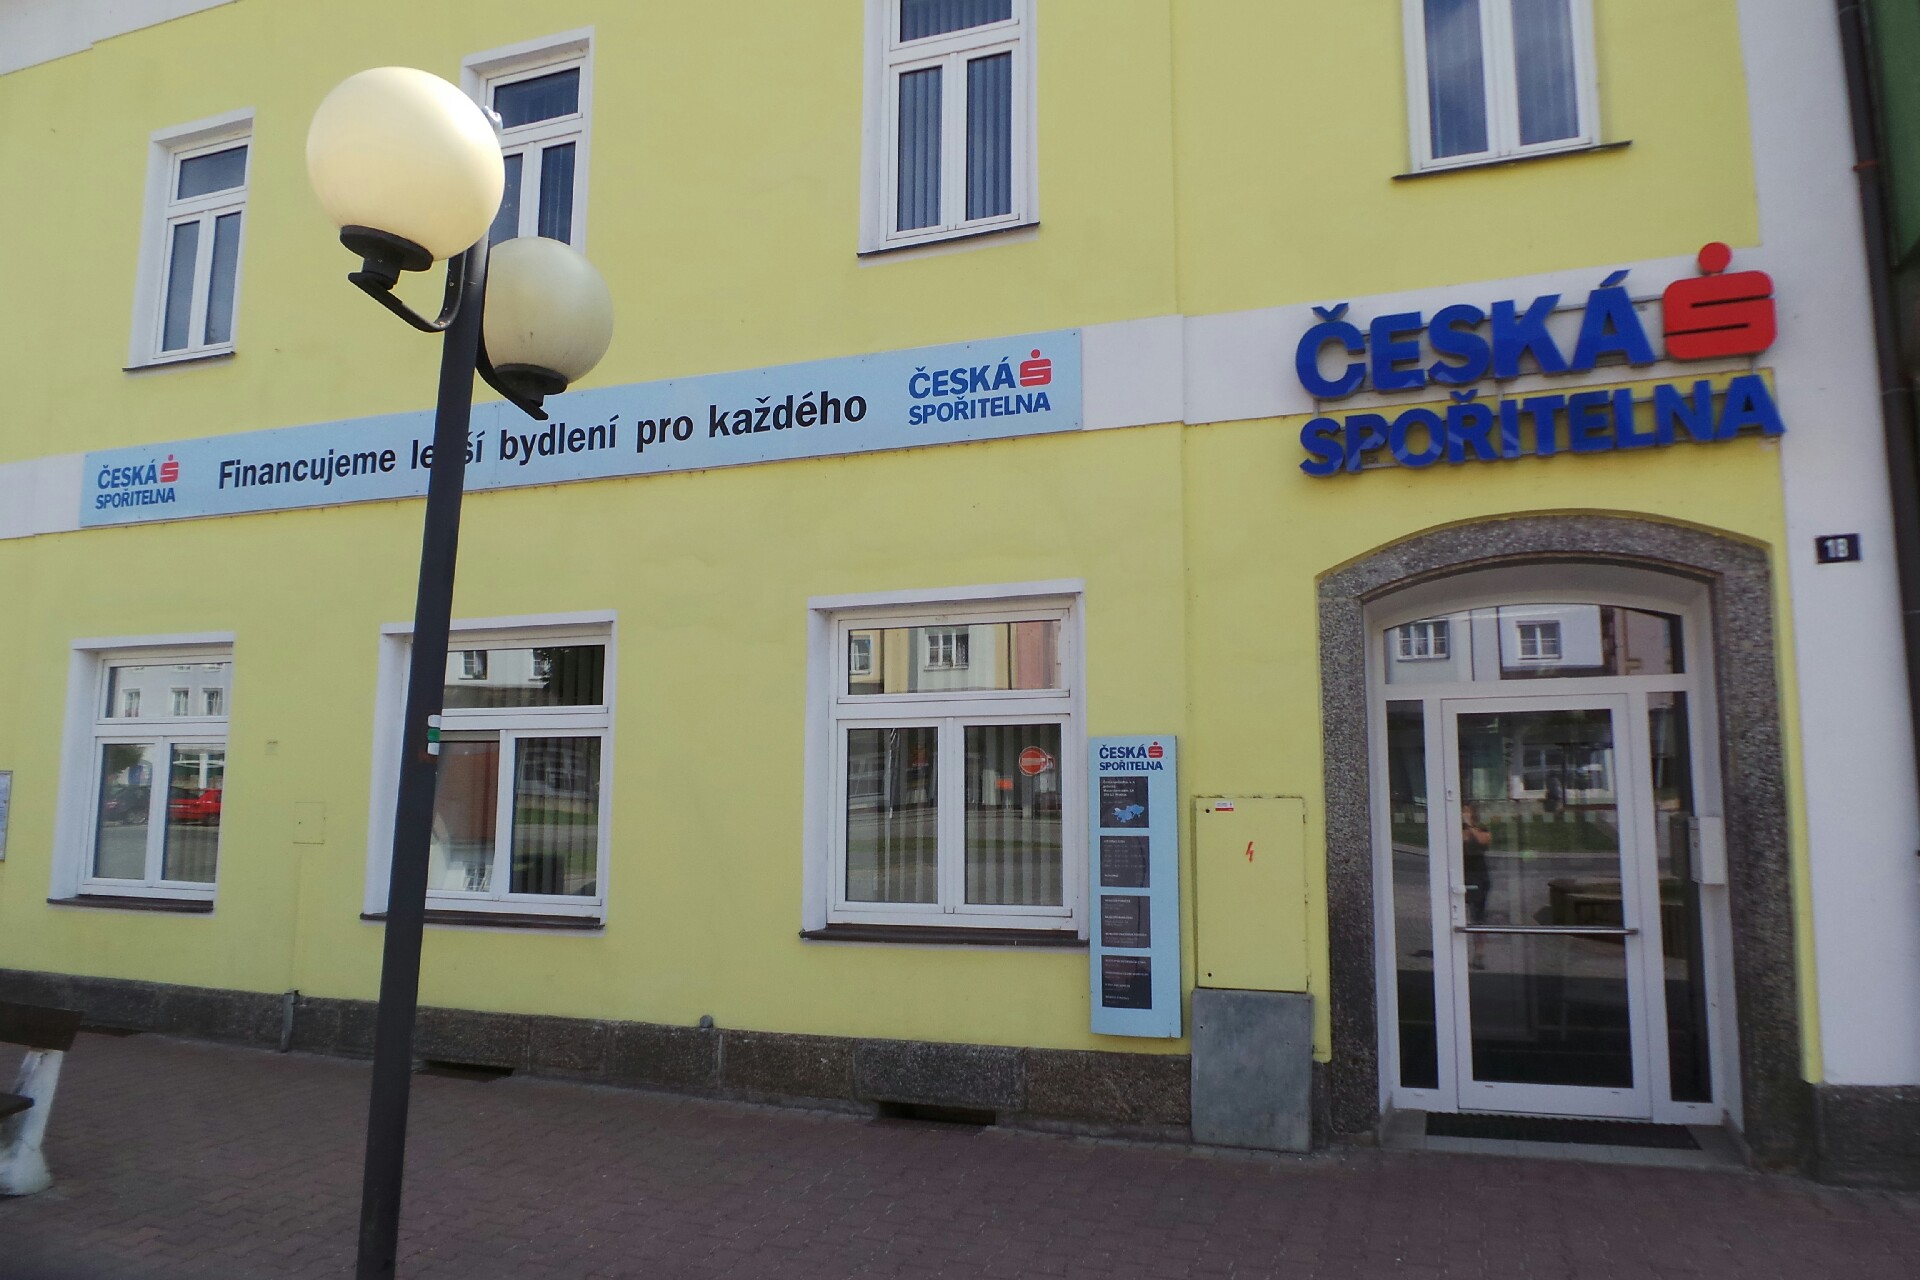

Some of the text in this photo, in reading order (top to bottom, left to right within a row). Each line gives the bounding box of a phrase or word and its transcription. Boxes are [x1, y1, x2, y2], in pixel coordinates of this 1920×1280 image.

[1295, 269, 1655, 400] ČESKÁ
[908, 357, 1016, 399] ČESKÁ
[908, 391, 1052, 425] SPOŘITELNA
[218, 391, 867, 489] Financujeme leí bydlení pro každého
[1299, 374, 1786, 477] SPOŘITELNA
[97, 459, 158, 490] ČESKÁ
[95, 487, 176, 510] SPOŘITELNA
[1099, 744, 1148, 759] ČESKÁ
[1099, 760, 1164, 771] SPOŘITELNA
